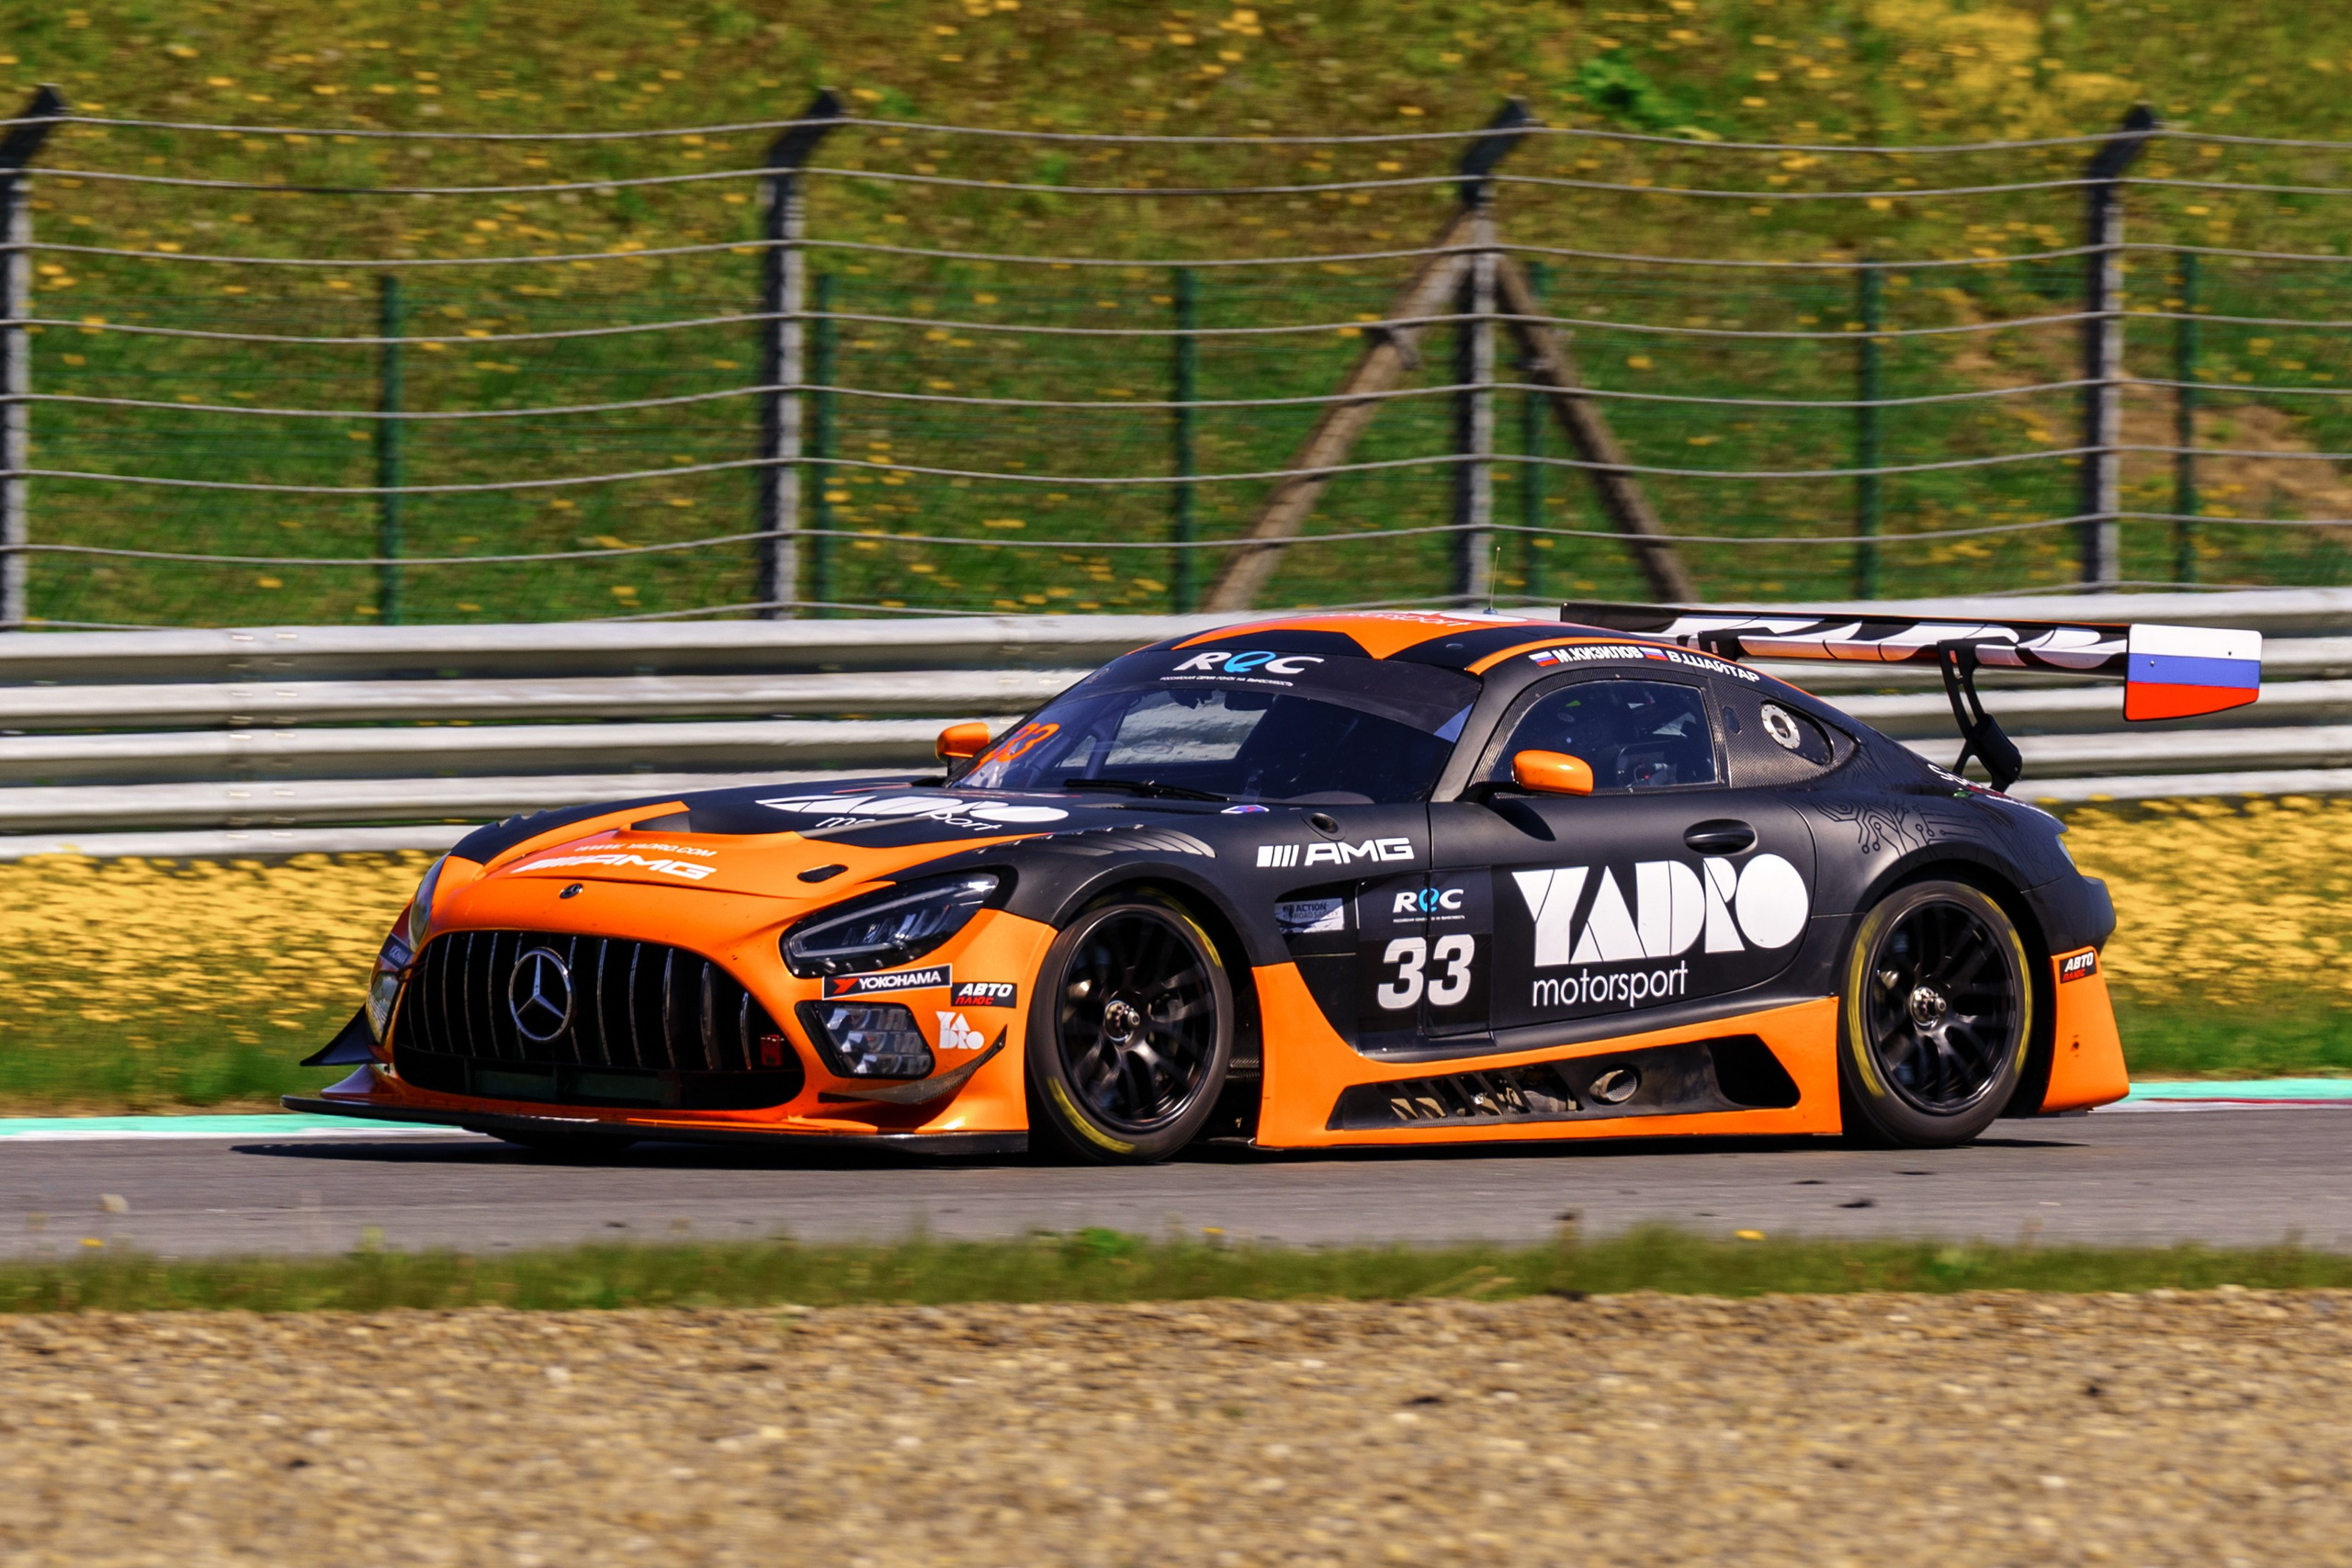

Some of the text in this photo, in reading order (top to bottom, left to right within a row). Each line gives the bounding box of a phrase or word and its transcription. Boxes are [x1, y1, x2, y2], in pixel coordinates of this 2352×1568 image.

[1554, 646, 1645, 663] М.КИЗИЛОВ
[1667, 650, 1760, 682] В.ШАЙТАР
[1304, 837, 1415, 866] AMG
[575, 853, 718, 880] AMG
[1296, 902, 1327, 912] ACTION
[1511, 853, 1809, 967] YADRO
[1377, 933, 1476, 1010] 33
[2064, 952, 2094, 973] АВТО
[859, 971, 942, 990] YOKOHAMA
[958, 983, 1012, 998] АВТО
[1532, 960, 1689, 1008] motorsport
[955, 997, 994, 1006] ПЛЮС
